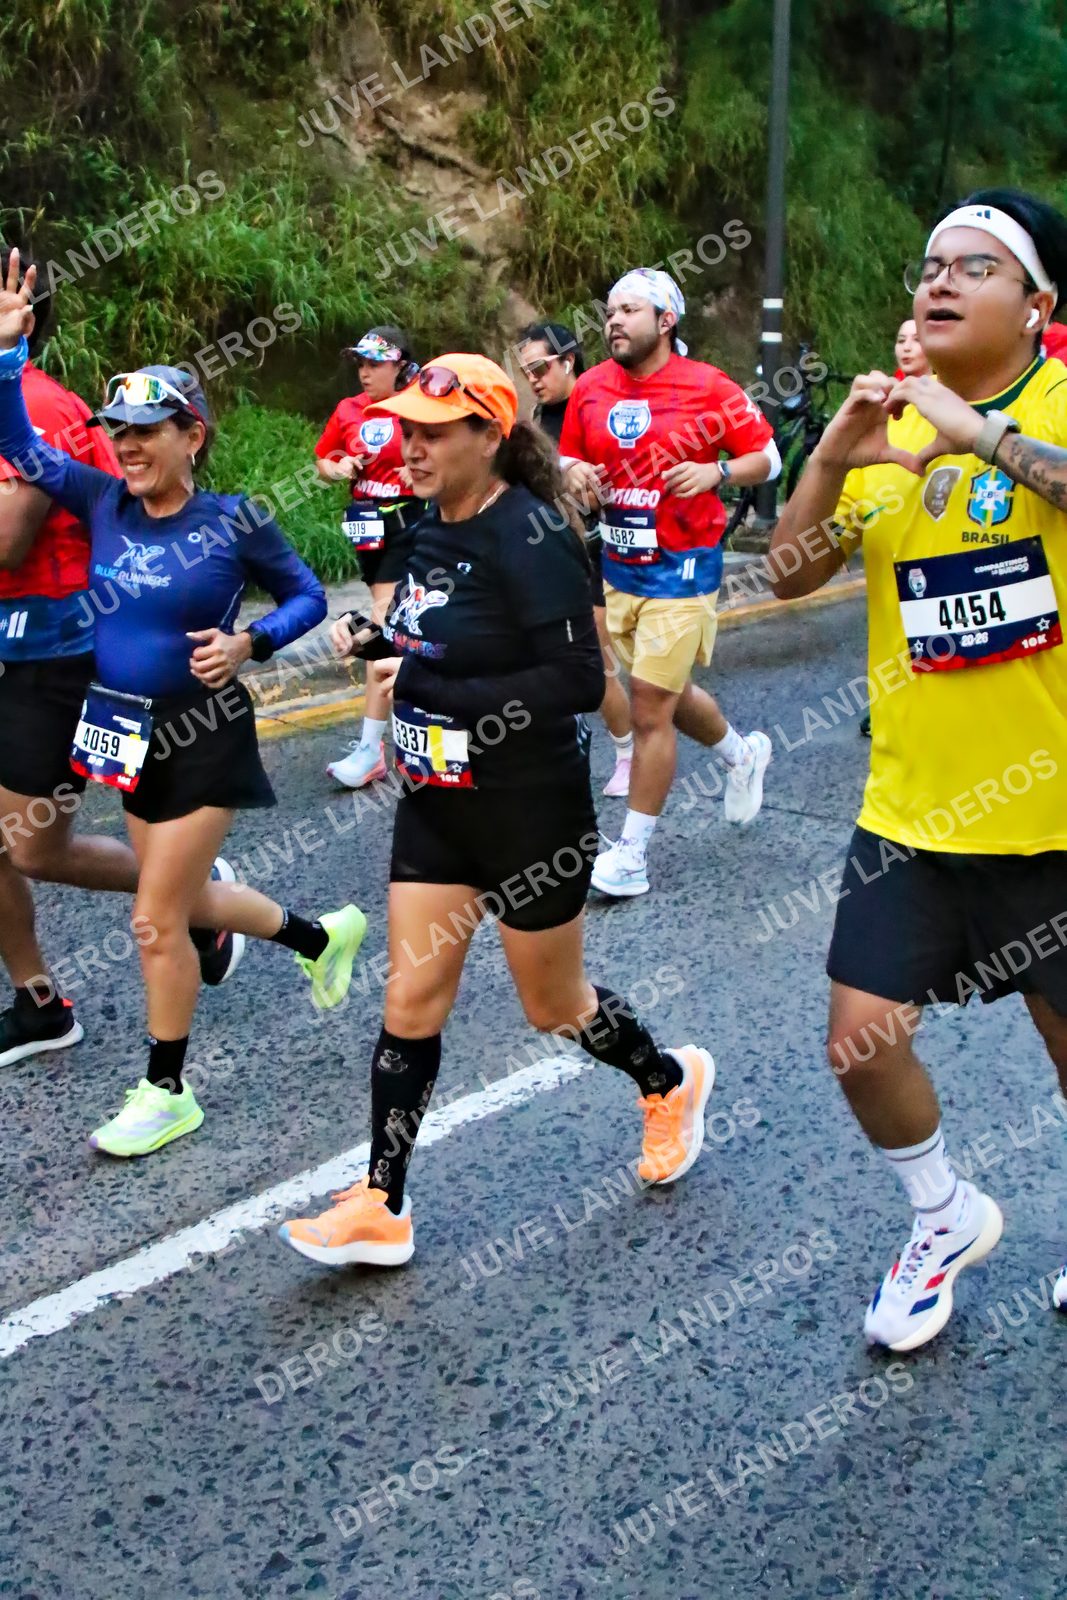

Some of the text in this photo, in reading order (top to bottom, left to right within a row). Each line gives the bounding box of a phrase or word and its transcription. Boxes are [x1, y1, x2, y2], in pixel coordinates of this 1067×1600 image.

[348, 522, 366, 535] 5319
[610, 527, 635, 546] 4582
[94, 564, 172, 588] BLUE RUNNERS
[938, 590, 1006, 631] 4454
[1021, 632, 1048, 649] 10K
[83, 726, 121, 757] 4059
[395, 720, 428, 754] 5337
